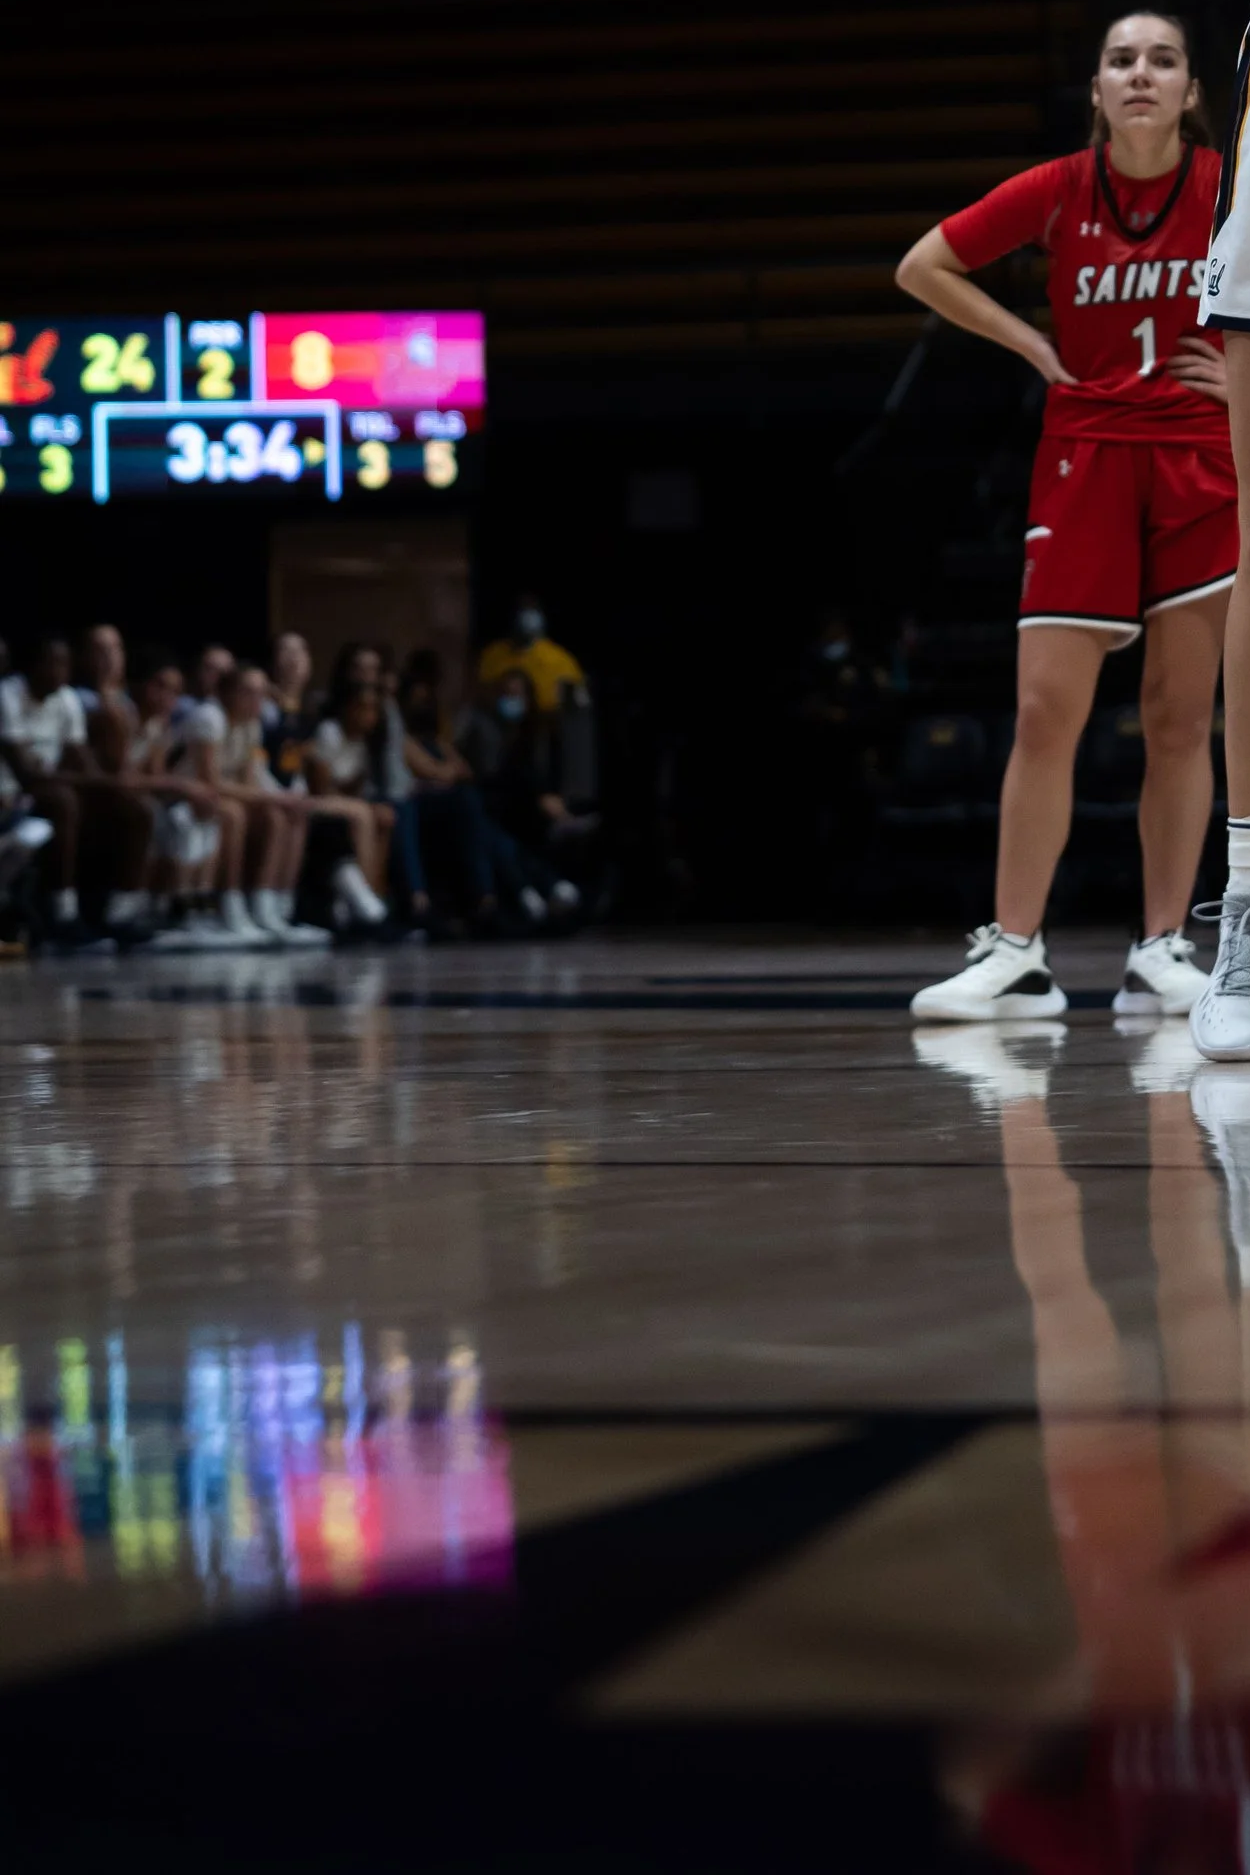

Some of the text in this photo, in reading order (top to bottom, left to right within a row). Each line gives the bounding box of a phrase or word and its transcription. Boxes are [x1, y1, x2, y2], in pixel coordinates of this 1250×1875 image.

[1073, 259, 1207, 307] SAINTS
[80, 332, 155, 394] 24
[1131, 316, 1156, 377] 1
[196, 348, 235, 400] 2
[38, 443, 74, 494] 3
[166, 419, 303, 484] 3:34
[357, 439, 391, 489] 3
